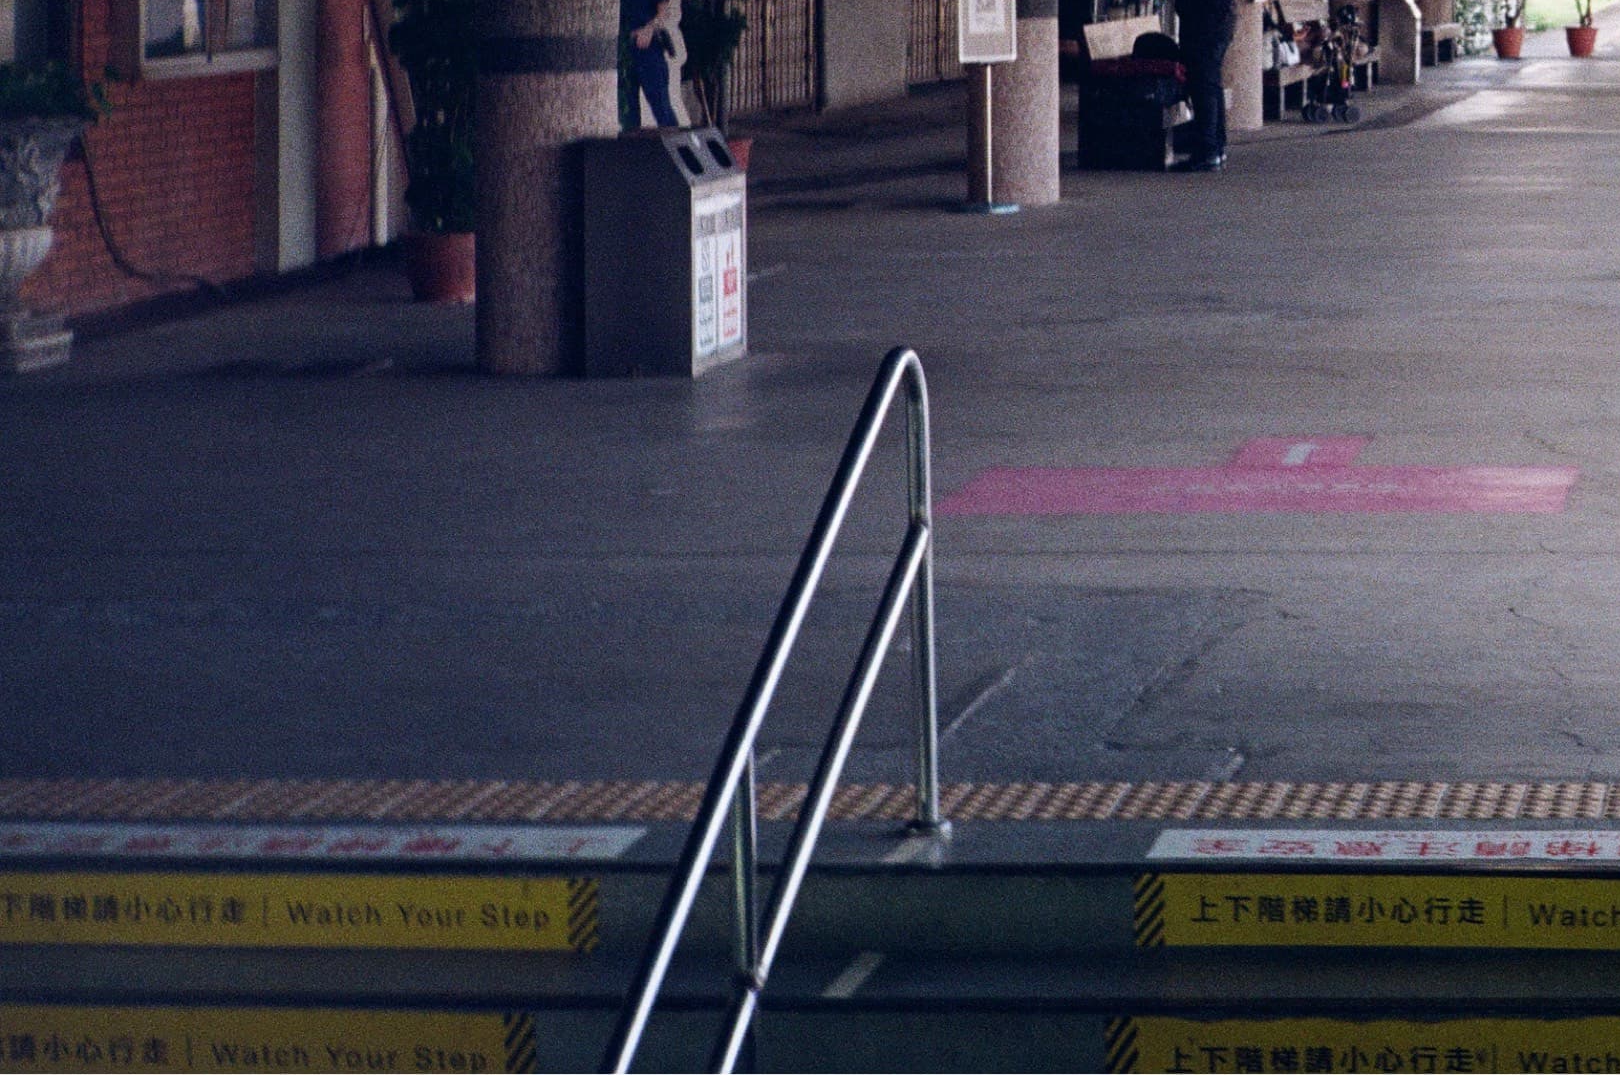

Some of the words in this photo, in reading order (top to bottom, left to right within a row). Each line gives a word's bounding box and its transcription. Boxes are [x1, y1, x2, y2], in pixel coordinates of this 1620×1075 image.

[285, 900, 383, 925] Watch
[397, 901, 467, 926] Your
[480, 902, 550, 931] Step
[1191, 895, 1485, 925] 上下階梯請小心行走
[210, 1044, 310, 1068] Watch
[324, 1045, 399, 1070] Your
[412, 1045, 489, 1072] Step
[1165, 1046, 1474, 1073] 上下階梯請小心行走
